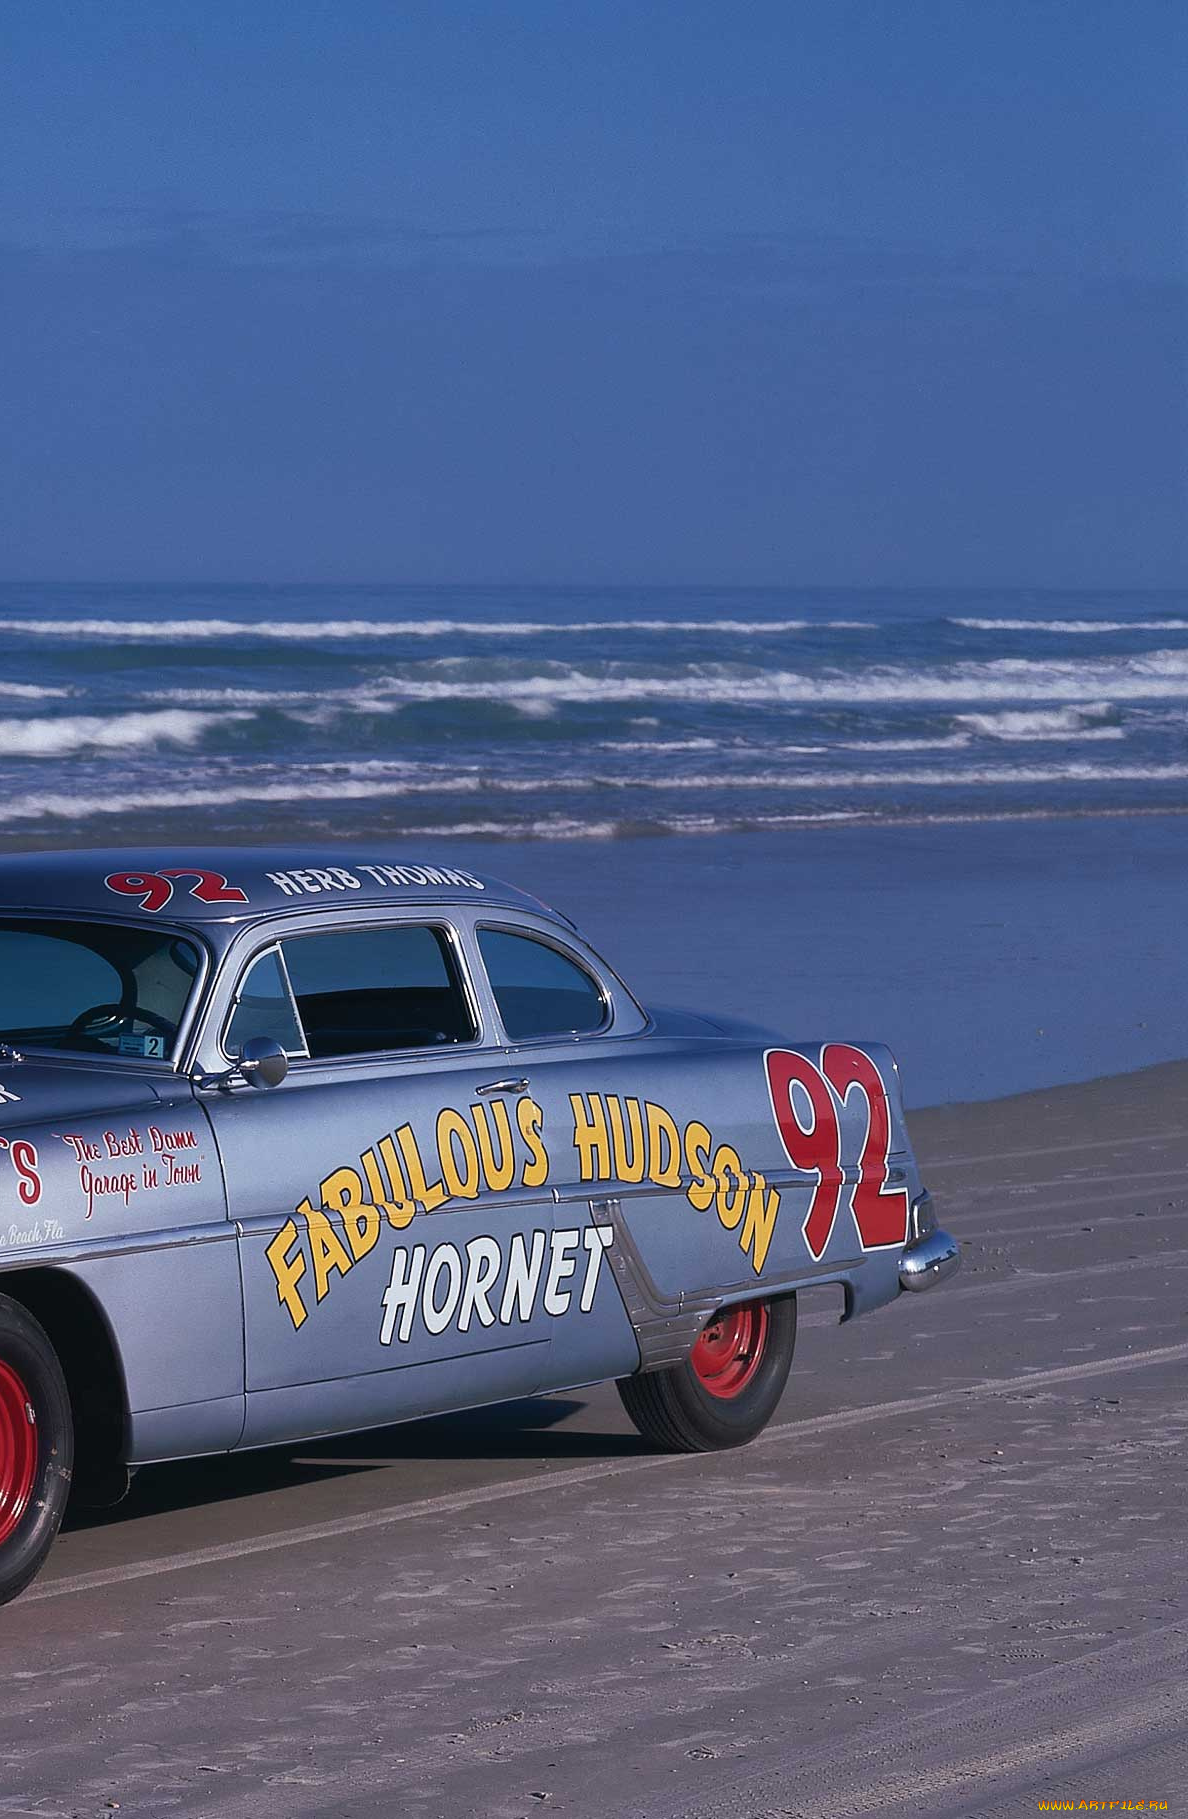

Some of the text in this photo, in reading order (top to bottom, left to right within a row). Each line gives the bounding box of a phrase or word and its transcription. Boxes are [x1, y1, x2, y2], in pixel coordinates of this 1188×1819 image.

[105, 868, 250, 913] 92
[265, 865, 486, 896] HERB THOMAS
[148, 1038, 159, 1056] 2
[102, 1127, 144, 1159] Best
[147, 1125, 199, 1153] Damn
[763, 1043, 910, 1262] 92
[79, 1164, 138, 1221] Garage
[141, 1163, 159, 1191] in
[265, 1092, 782, 1332] FABULOUS HUDSON
[378, 1226, 615, 1347] HORNET
